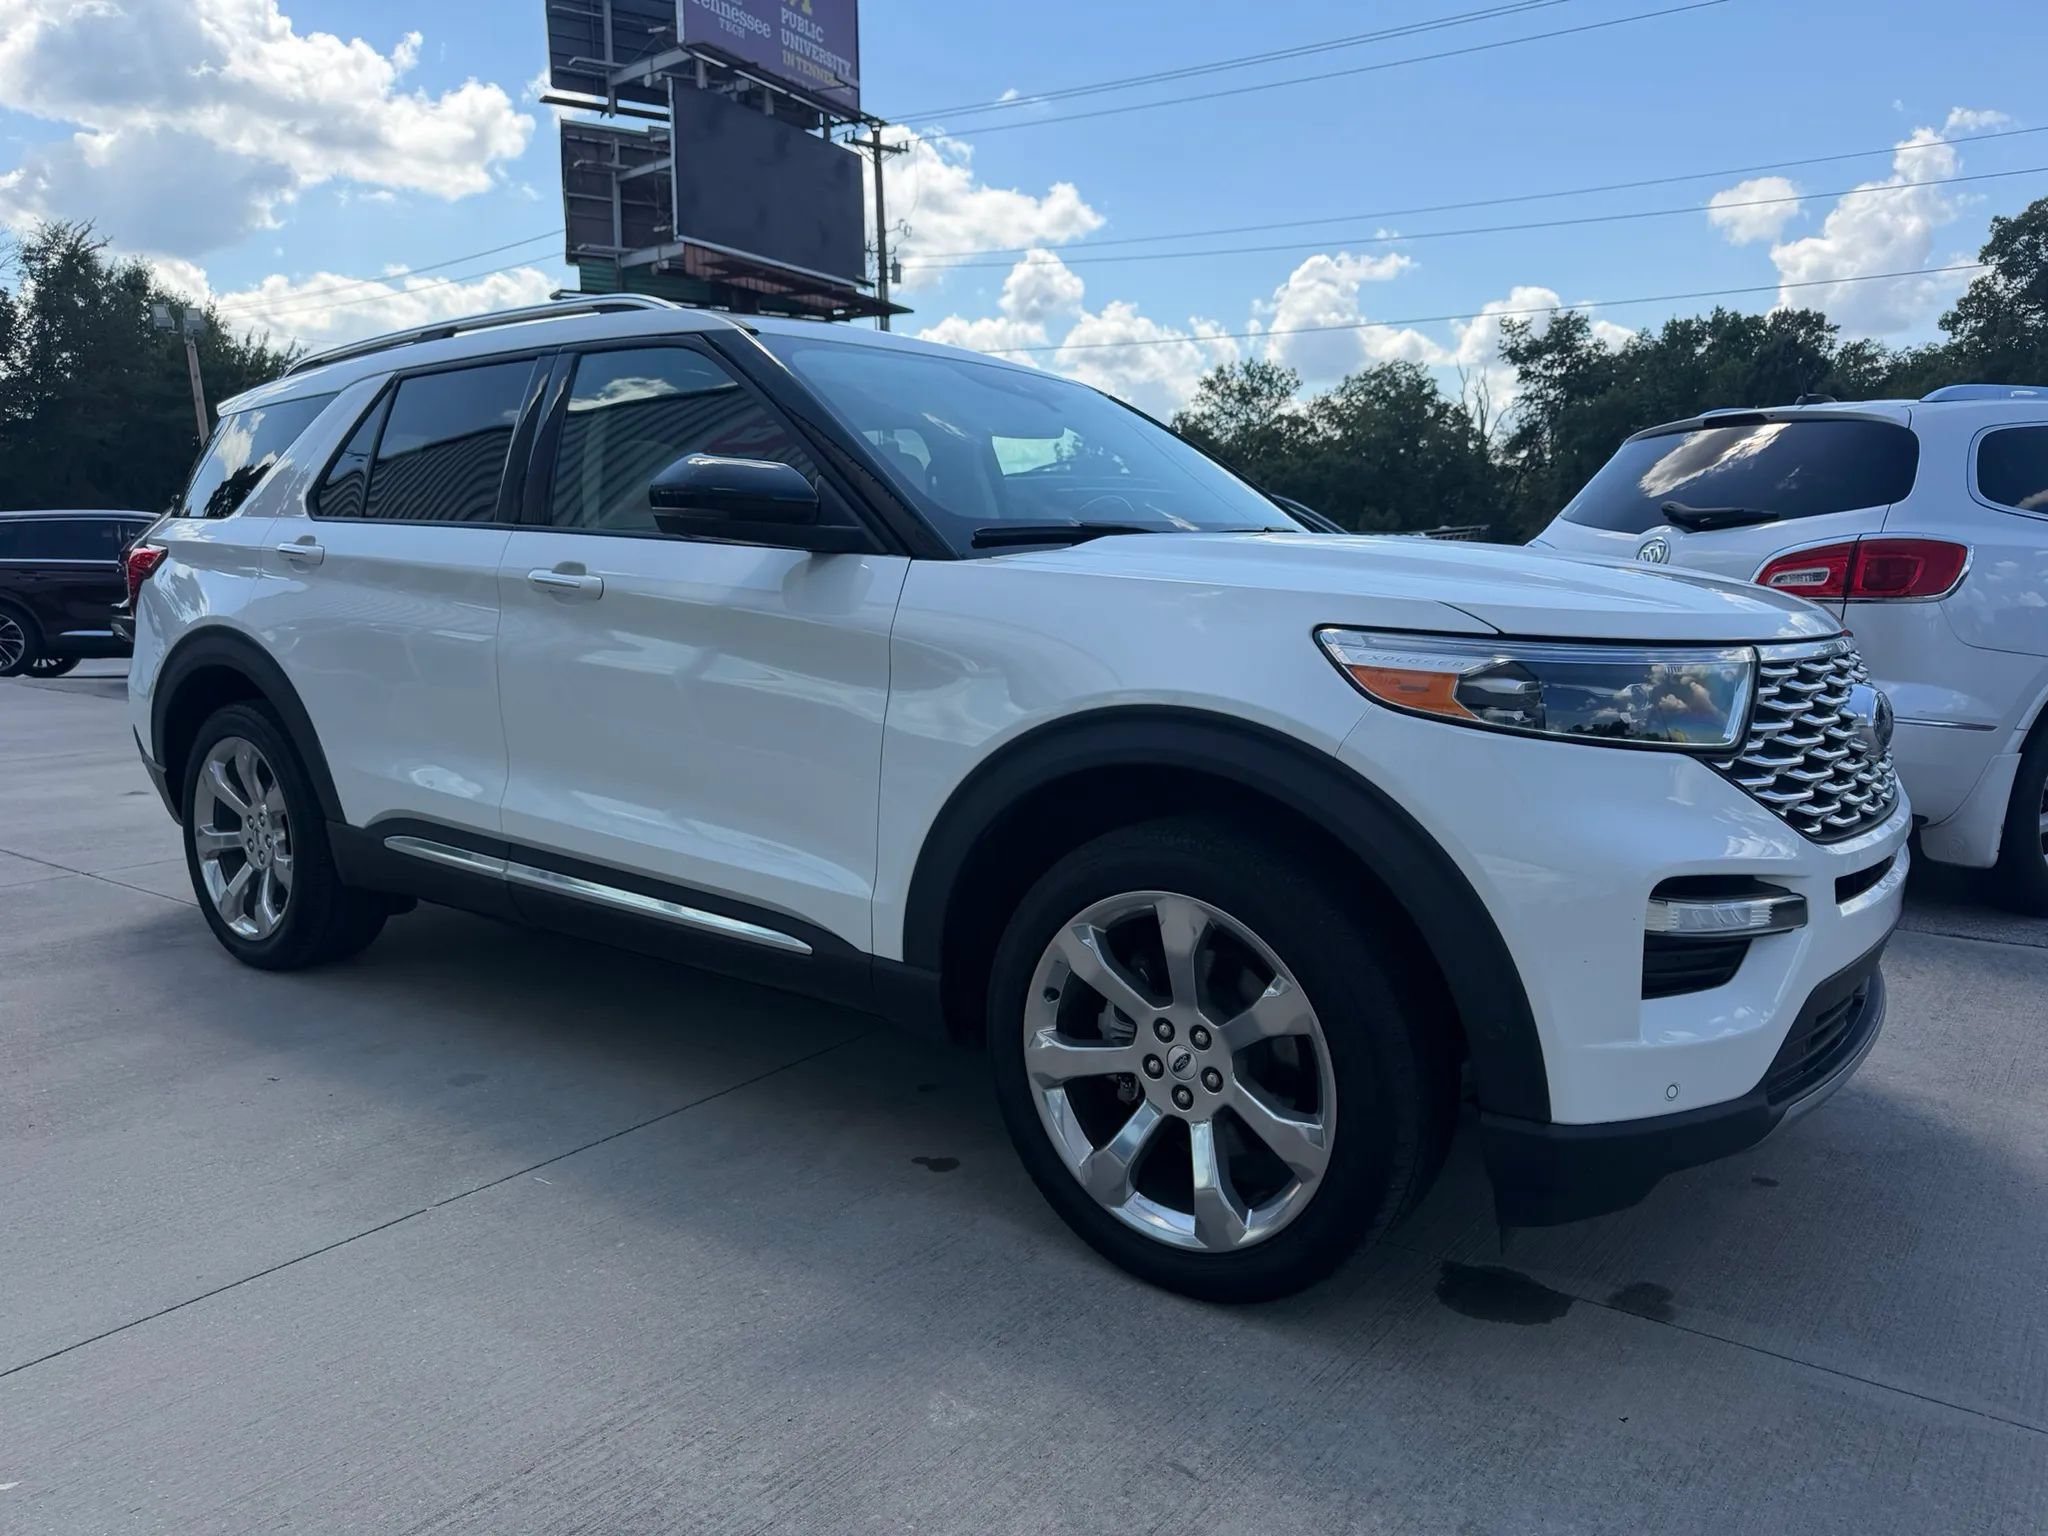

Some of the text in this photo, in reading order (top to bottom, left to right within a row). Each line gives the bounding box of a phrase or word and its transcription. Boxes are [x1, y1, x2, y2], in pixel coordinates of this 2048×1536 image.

[692, 0, 772, 38] ennessee
[718, 17, 745, 40] TECH
[781, 7, 824, 43] PUBLIC
[781, 28, 851, 77] UNIVERSITY
[783, 50, 796, 70] IN
